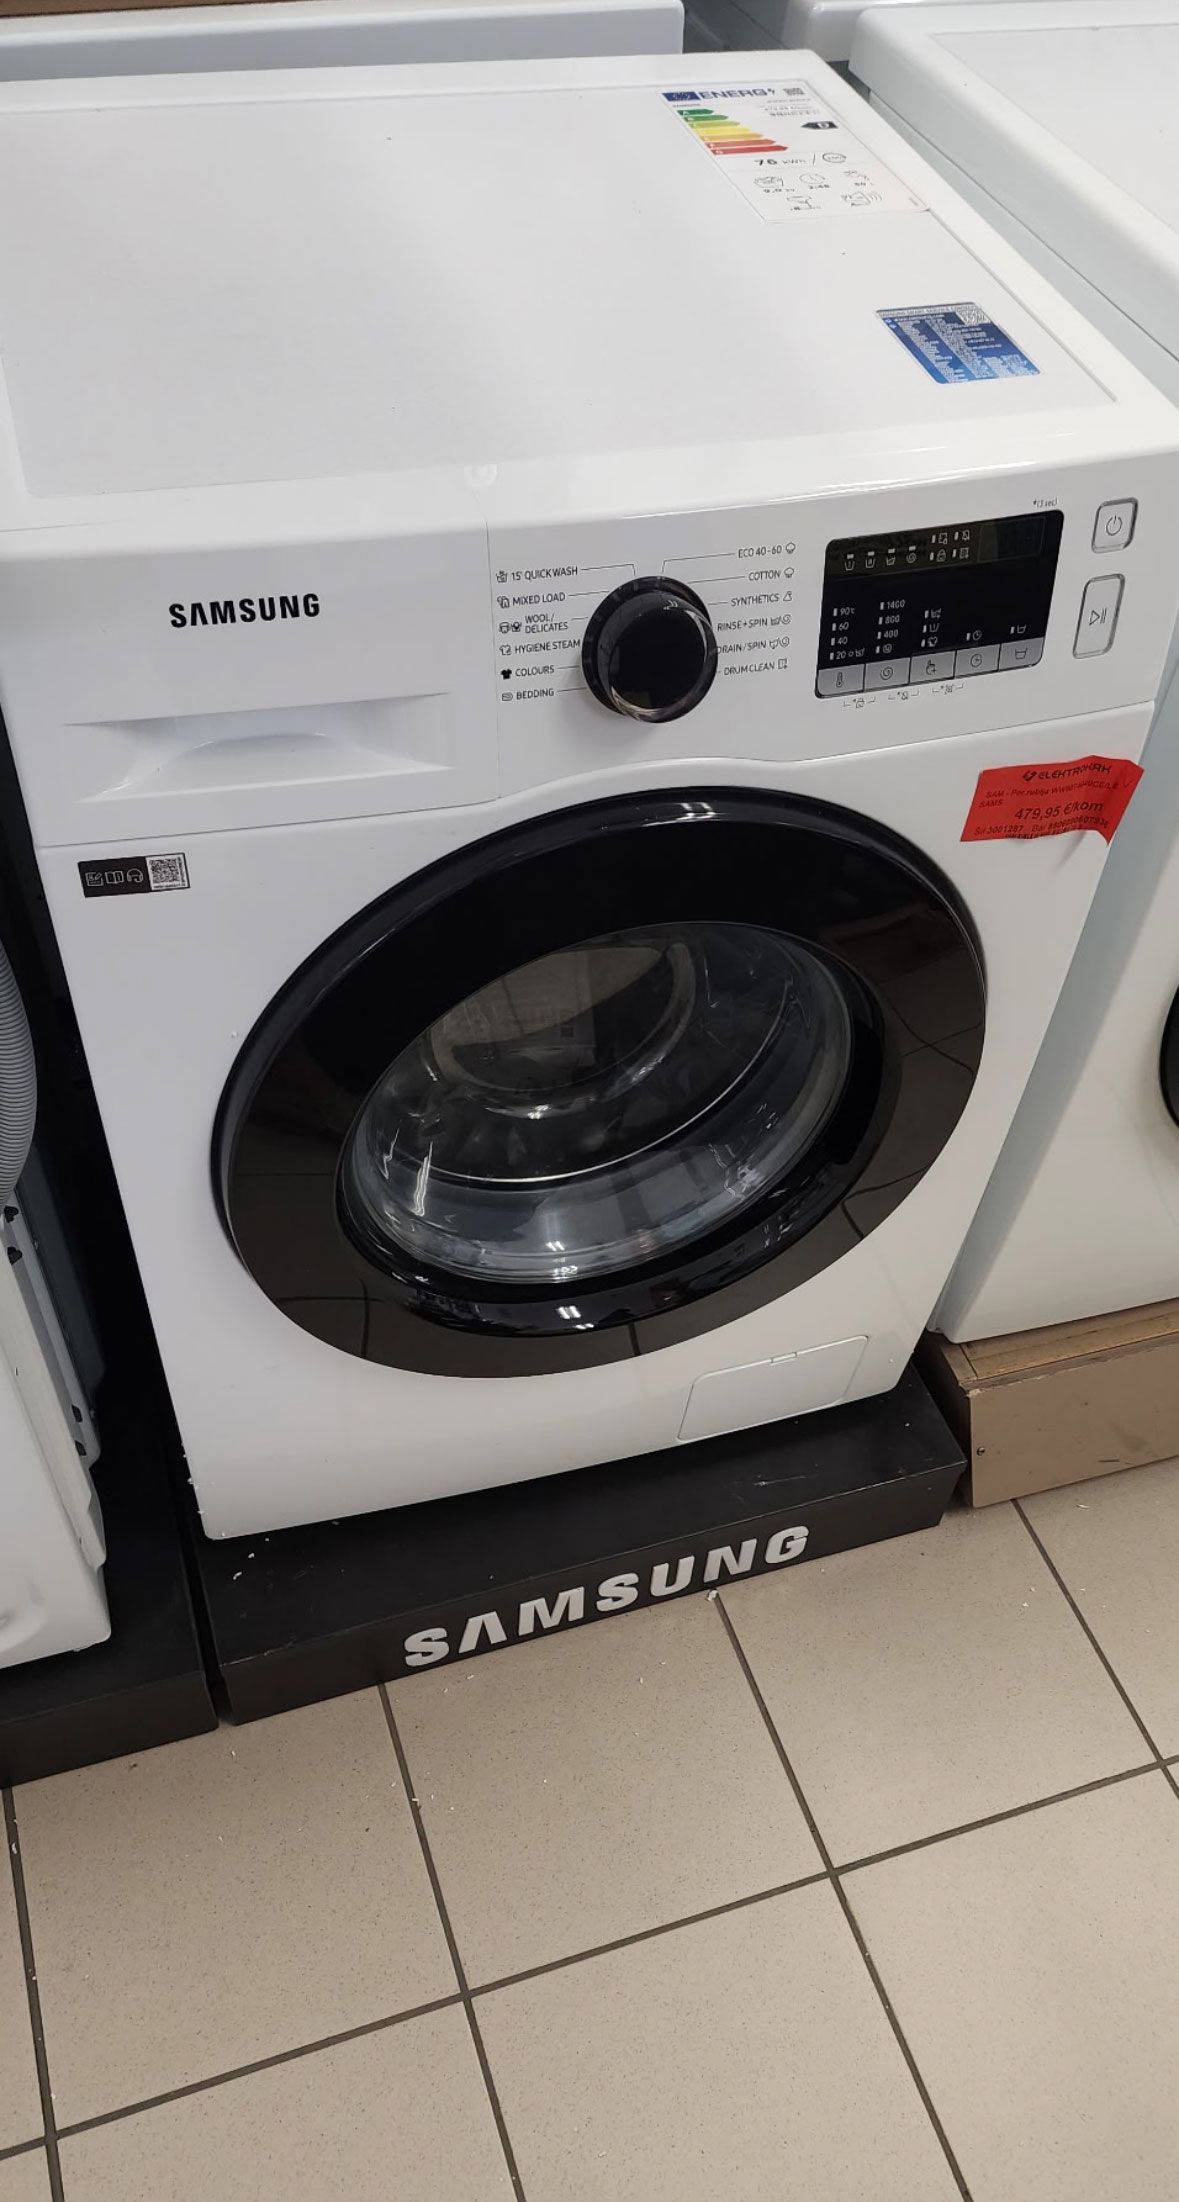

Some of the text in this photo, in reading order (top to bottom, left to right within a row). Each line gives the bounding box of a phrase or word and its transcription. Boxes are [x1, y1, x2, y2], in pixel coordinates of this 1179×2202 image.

[738, 548, 754, 558] ECO
[524, 568, 551, 580] QUICK
[553, 566, 578, 577] WASH
[748, 570, 781, 581] COTTON
[512, 592, 565, 606] MIXED LOAD
[730, 593, 780, 607] SYNTHETICS
[886, 599, 905, 609] 1400
[168, 593, 320, 628] SAMSUNG
[885, 615, 900, 624] 800
[525, 622, 568, 634] DELICATES
[838, 621, 849, 631] 60
[883, 629, 899, 638] 400
[514, 638, 581, 654] HYGIENE STEAM
[837, 636, 848, 645] 40
[836, 650, 846, 660] 20
[515, 665, 555, 677] COLOURS
[724, 661, 775, 676] DRUM CLEAN
[516, 688, 554, 700] BEDDING
[1014, 801, 1104, 821] 479,95 €/kom
[403, 1525, 810, 1668] SAMSUNG
